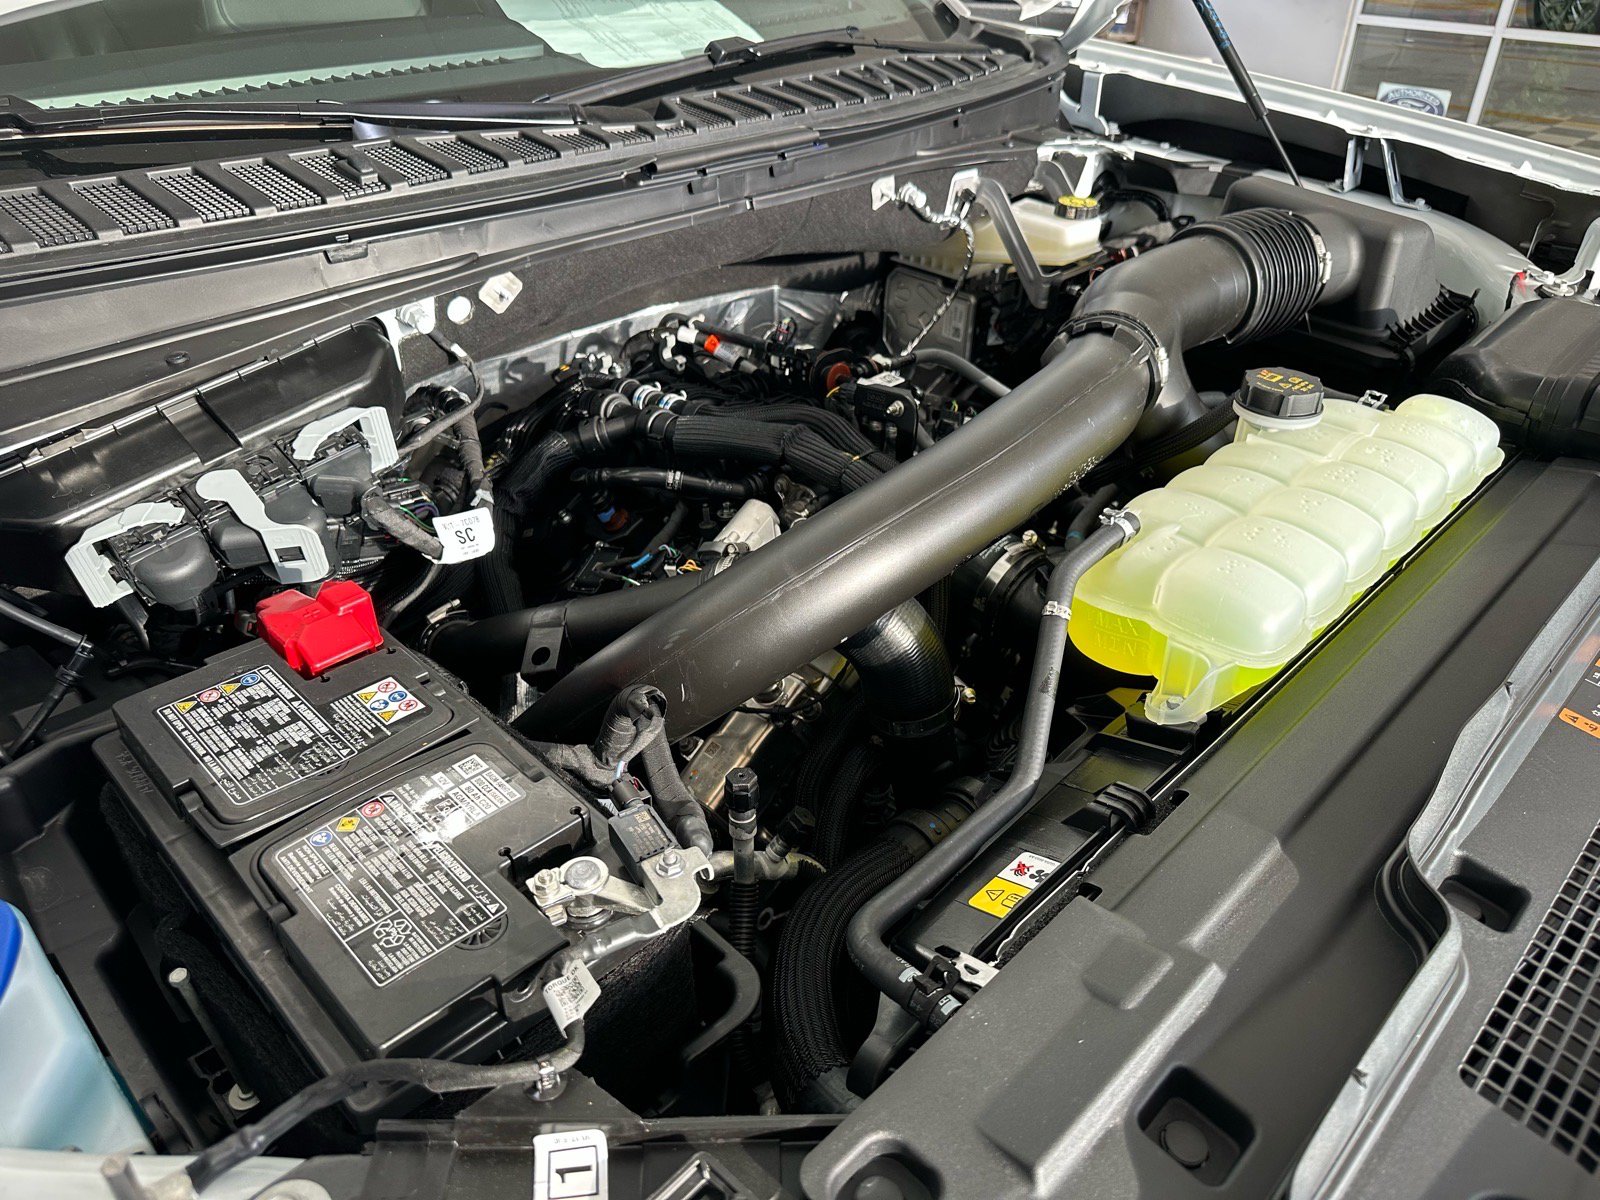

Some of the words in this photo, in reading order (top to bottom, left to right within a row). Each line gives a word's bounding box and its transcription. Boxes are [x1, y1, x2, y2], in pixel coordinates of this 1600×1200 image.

[454, 527, 476, 544] SC
[1094, 632, 1137, 657] MIN
[470, 791, 482, 800] Ah
[294, 847, 306, 858] Lead
[301, 856, 313, 867] Acid
[307, 864, 324, 880] Battery
[301, 844, 330, 875] NON-SPILLABLE
[429, 842, 472, 882] PELIGRO/VENENO
[334, 882, 352, 902] CONTRA
[347, 899, 371, 924] DERRAMES
[387, 926, 399, 937] Pb
[570, 965, 579, 976] OK
[544, 975, 570, 994] TORQUE
[554, 1165, 592, 1184] 1
